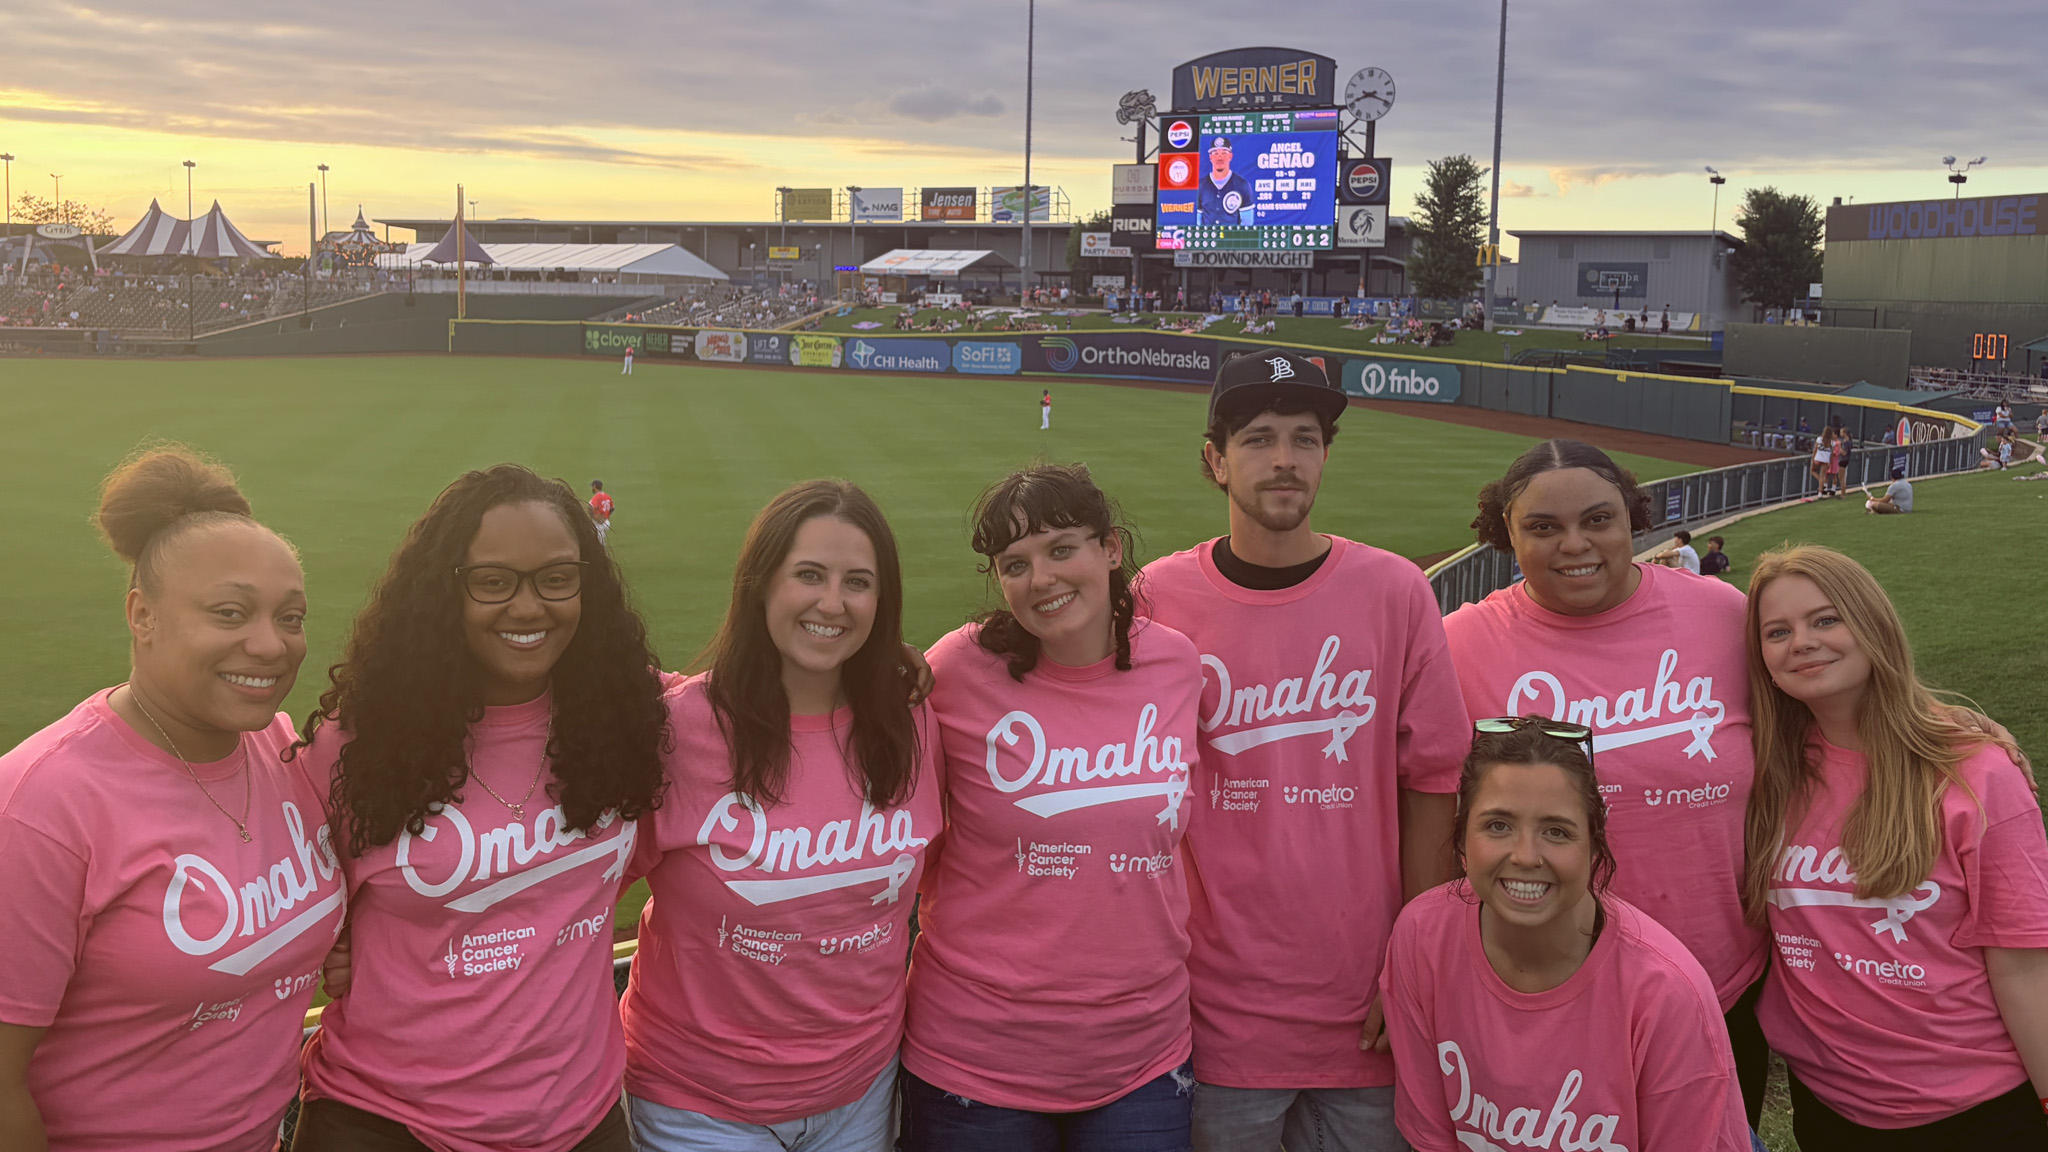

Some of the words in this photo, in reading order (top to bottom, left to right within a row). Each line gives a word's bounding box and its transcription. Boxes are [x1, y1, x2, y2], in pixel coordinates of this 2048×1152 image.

[1192, 58, 1316, 100] WERNER
[1222, 95, 1283, 104] PARK
[1270, 143, 1303, 153] ANGEL
[1257, 152, 1315, 169] GENAO
[872, 203, 898, 212] NMG
[930, 192, 972, 207] Jensen
[1161, 202, 1195, 213] WERNER
[1867, 197, 2038, 239] WOODHOUSE
[1293, 233, 1302, 246] 0
[1306, 233, 1315, 246] 1
[1319, 233, 1329, 246] 2
[1196, 252, 1311, 266] DOWNDRAUGHT
[600, 330, 642, 348] clover
[754, 339, 767, 349] LIFT
[1973, 333, 2008, 359] 0:07
[874, 356, 895, 367] CHI
[899, 355, 939, 369] Health
[961, 346, 995, 362] SoFi
[1081, 345, 1210, 371] OrthoNebraska
[1388, 367, 1440, 396] fnbo
[986, 703, 1188, 793] Omaha
[1223, 778, 1269, 788] American
[1223, 789, 1258, 799] Cancer
[1301, 783, 1355, 803] metro
[1667, 782, 1730, 804] metro
[1222, 800, 1258, 813] Society
[1688, 801, 1709, 809] Credit
[1029, 842, 1091, 854] American
[1029, 854, 1075, 865] Cancer
[1129, 851, 1173, 872] metro
[1027, 865, 1075, 880] Society
[461, 926, 536, 949] American
[733, 923, 802, 941] American
[1775, 931, 1822, 948] American
[732, 934, 784, 953] Cancer
[462, 943, 519, 962] Cancer
[732, 943, 784, 966] Society
[464, 955, 523, 977] Society
[1856, 958, 1925, 980] metro
[1878, 977, 1902, 986] Credit
[1904, 979, 1926, 987] Union
